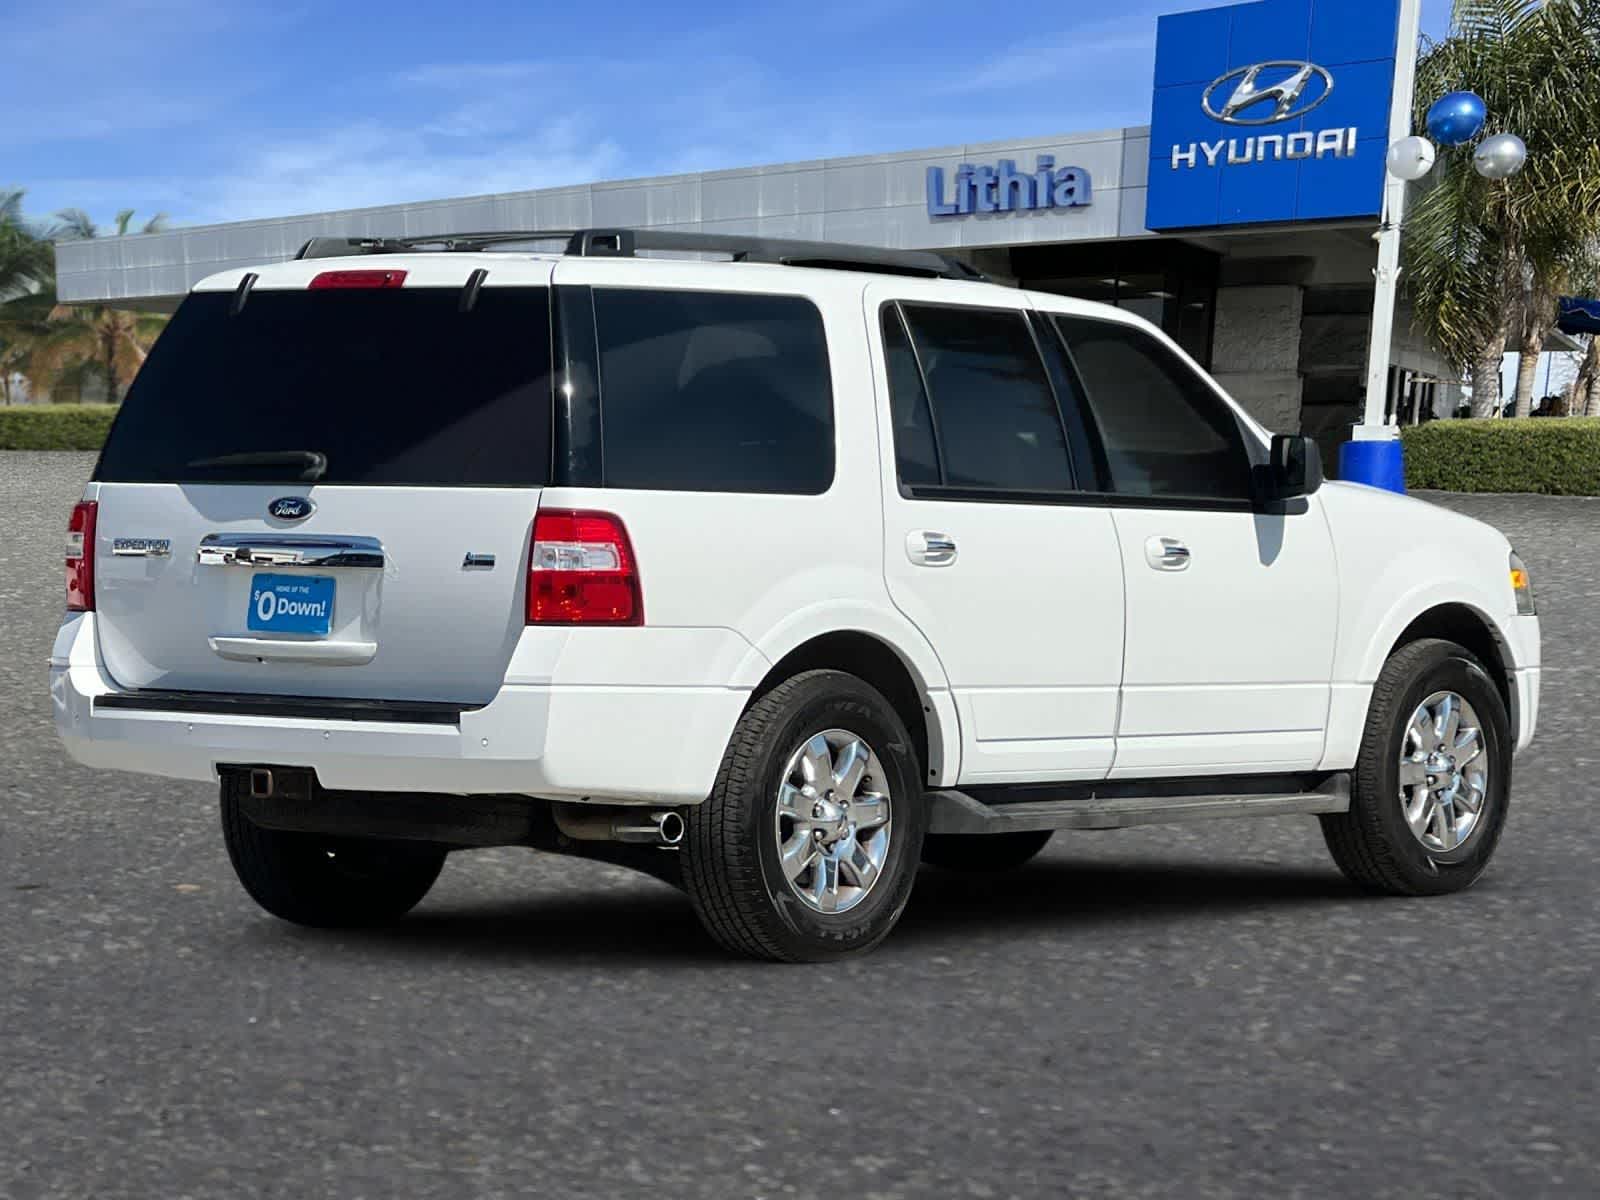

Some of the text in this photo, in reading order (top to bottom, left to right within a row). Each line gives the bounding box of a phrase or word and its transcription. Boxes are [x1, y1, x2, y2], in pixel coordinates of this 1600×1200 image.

[1171, 127, 1358, 169] HYUNDAI
[926, 155, 1093, 216] Lithia
[275, 500, 303, 516] Ford
[113, 538, 170, 550] EXPEDITION
[277, 598, 326, 617] Down!
